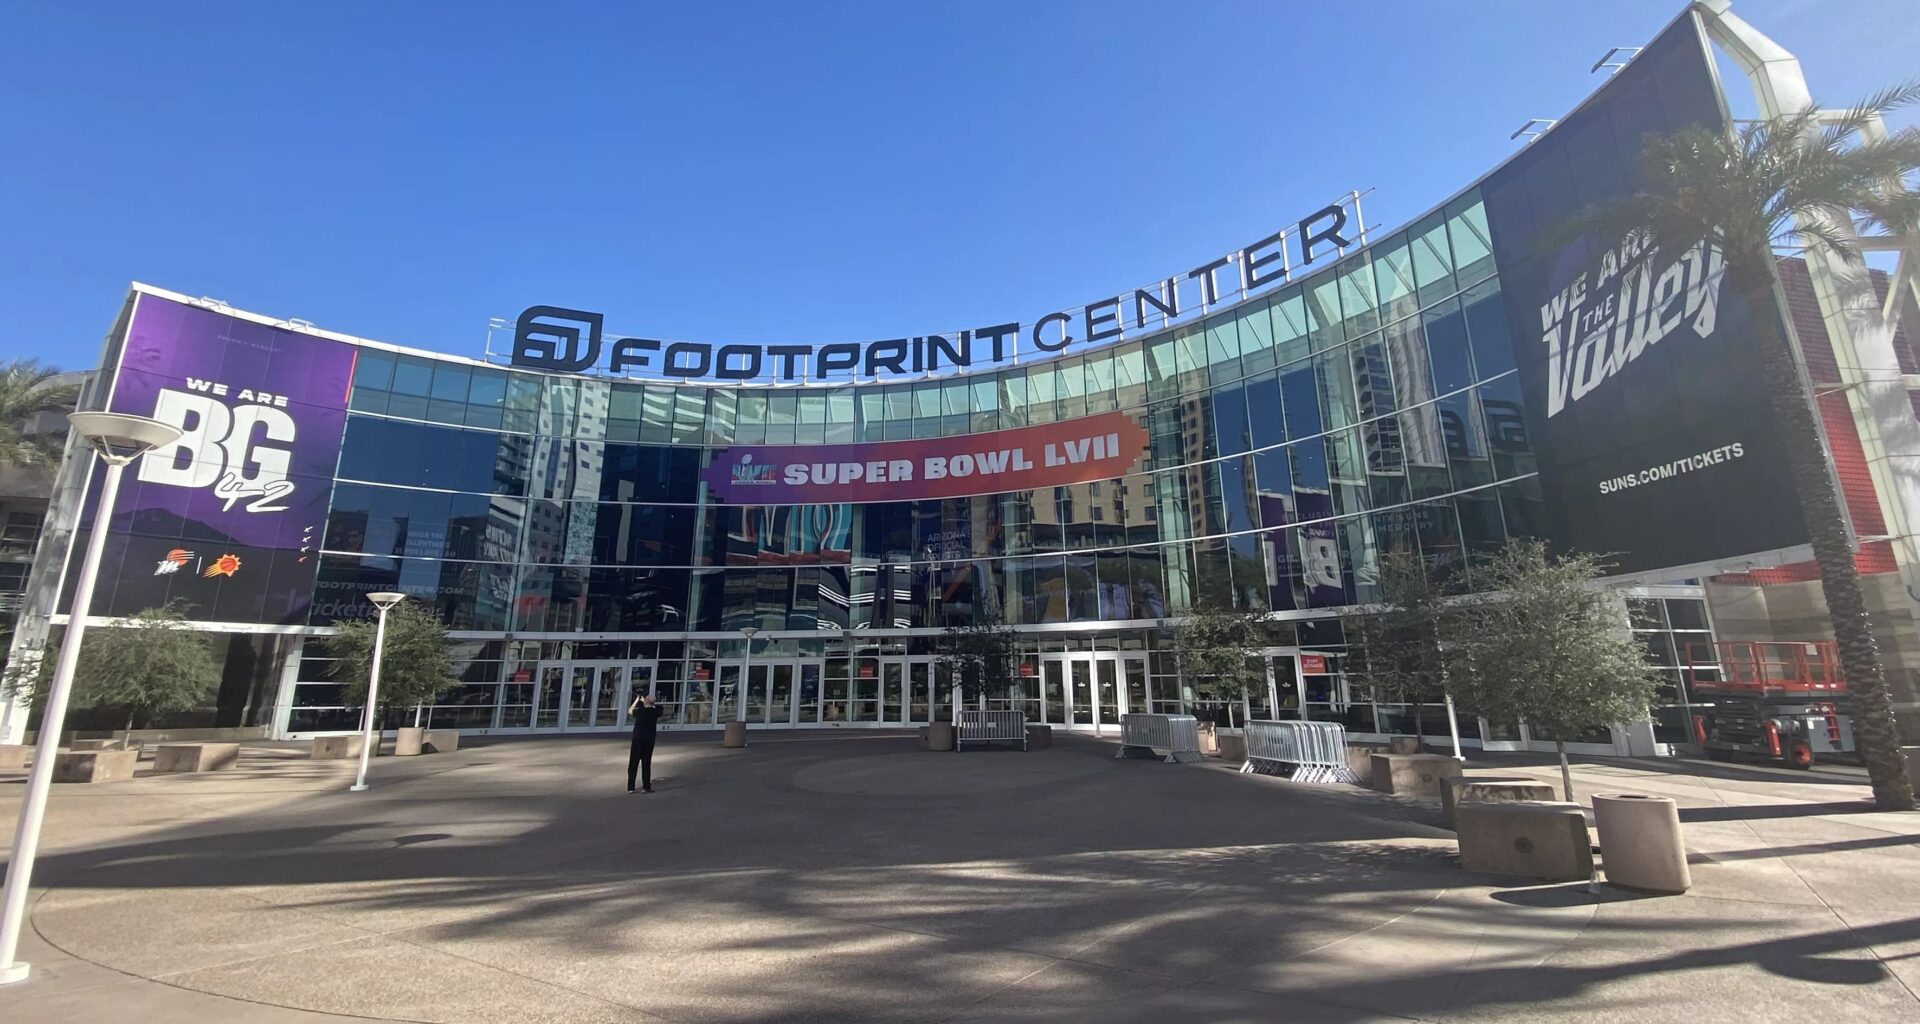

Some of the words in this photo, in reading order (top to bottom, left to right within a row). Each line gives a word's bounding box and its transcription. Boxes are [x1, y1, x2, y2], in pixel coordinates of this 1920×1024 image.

[610, 322, 1019, 381] FOOTPRINT
[1033, 204, 1350, 352] CENTER
[1540, 271, 1588, 332] WE
[1583, 293, 1614, 332] THE
[1542, 225, 1729, 419] Valley
[186, 377, 229, 396] WE
[238, 389, 289, 407] ARE
[137, 388, 296, 488] BG
[783, 459, 914, 486] SUPER
[924, 448, 1034, 480] BOWL
[1044, 433, 1120, 468] LVII
[214, 472, 295, 513] 42
[1599, 442, 1744, 495] SUNS.COM/TICKETS
